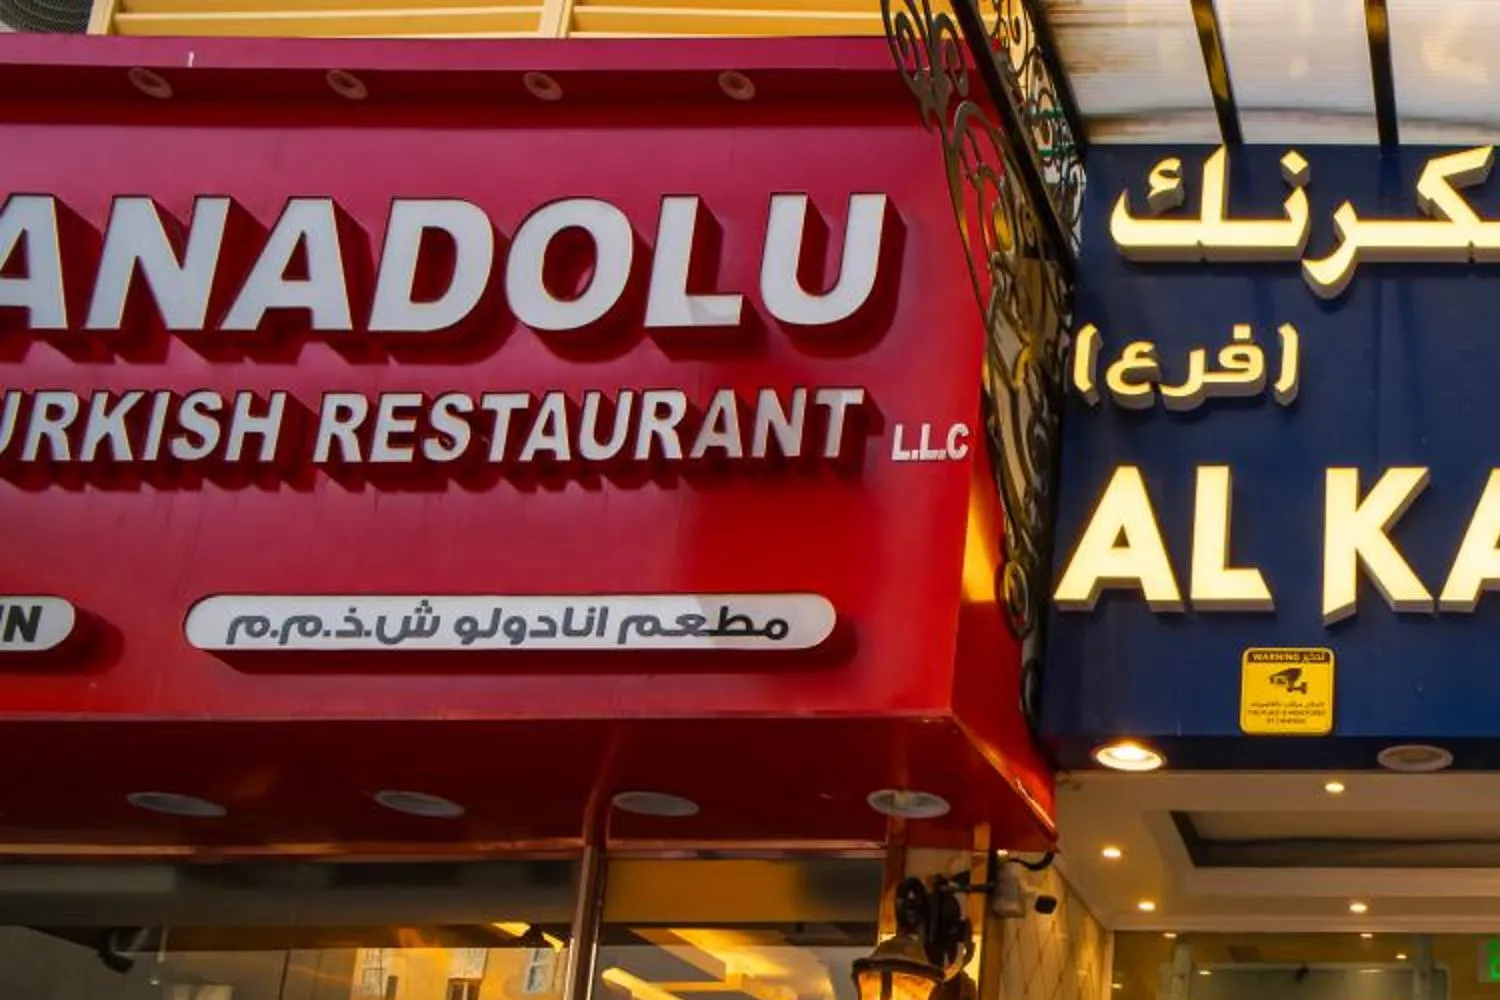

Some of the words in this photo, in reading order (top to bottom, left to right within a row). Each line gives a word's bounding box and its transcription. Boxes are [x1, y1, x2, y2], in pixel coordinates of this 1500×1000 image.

[0, 193, 887, 331] ANADOLU
[1073, 323, 1302, 408] (فرع)
[315, 387, 864, 463] RESTAURANT
[891, 422, 970, 461] L.L.C
[1054, 466, 1274, 613] AL
[454, 606, 609, 646] انادولو
[618, 605, 790, 645] مطعم
